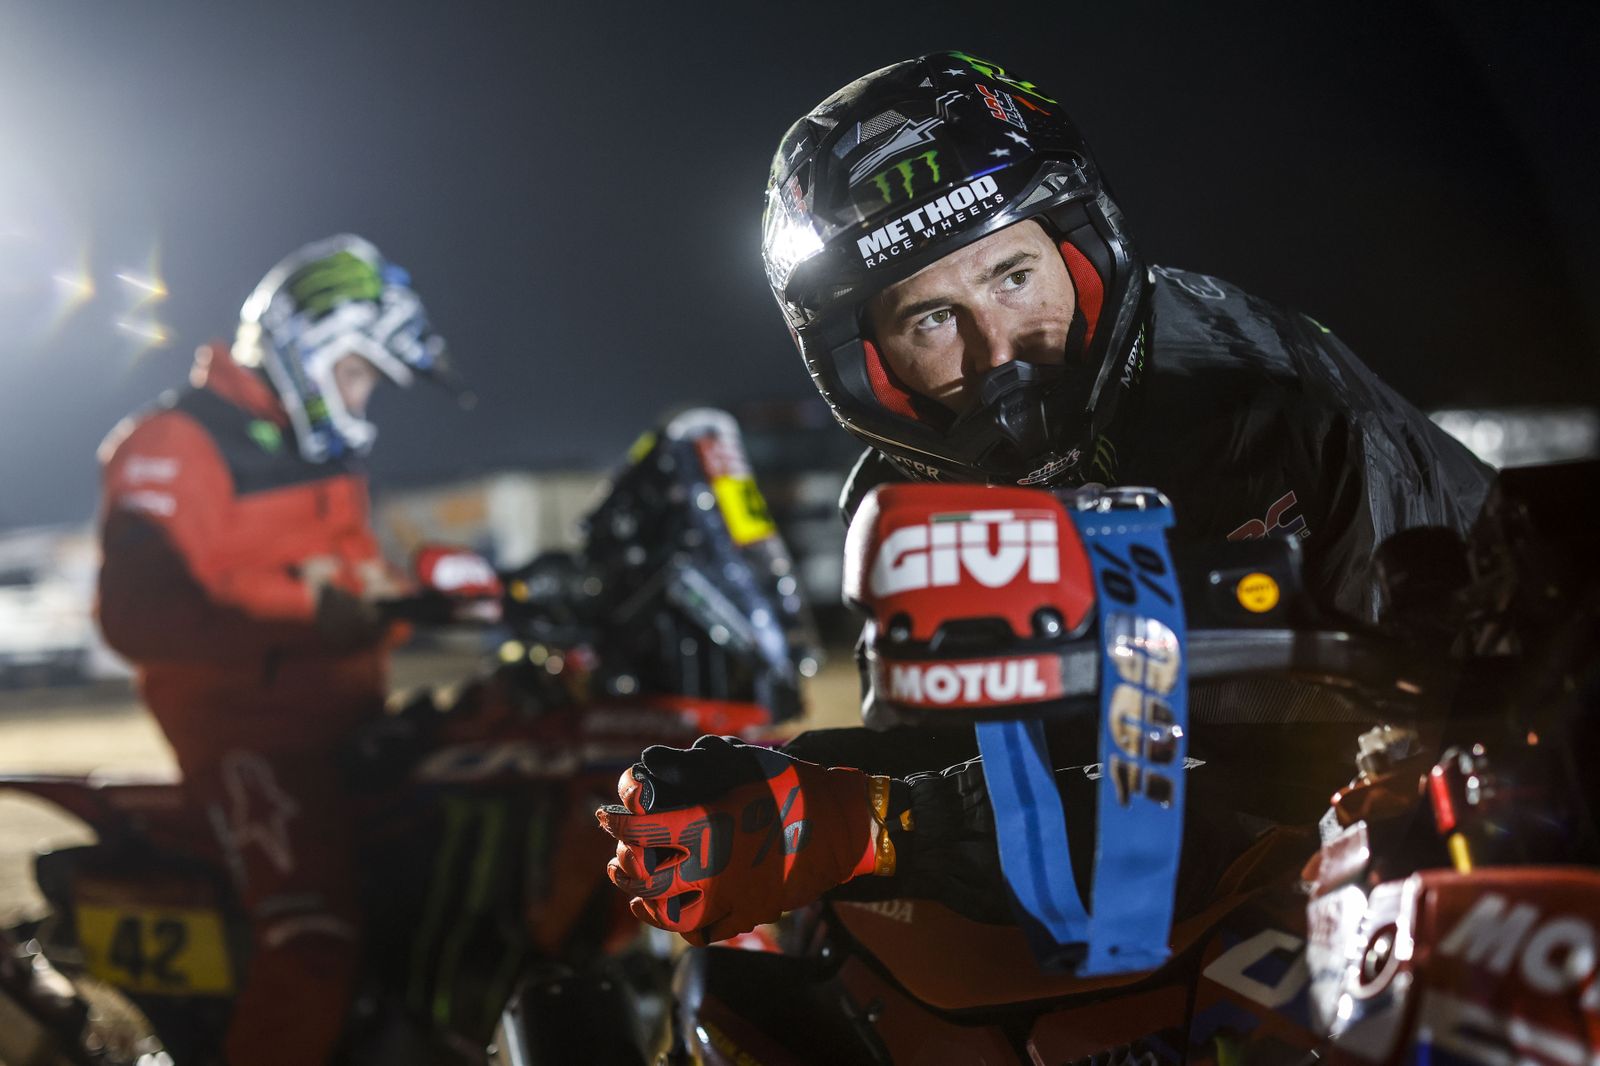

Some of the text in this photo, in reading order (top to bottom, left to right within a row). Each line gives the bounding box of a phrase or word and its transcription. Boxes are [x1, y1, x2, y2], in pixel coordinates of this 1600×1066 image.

[856, 175, 999, 259] METHOD
[866, 193, 1005, 269] RACE WHEELS
[868, 519, 1060, 599] GIVI
[889, 658, 1047, 704] MOTUL
[107, 916, 190, 987] 42
[1437, 893, 1600, 995] MO
